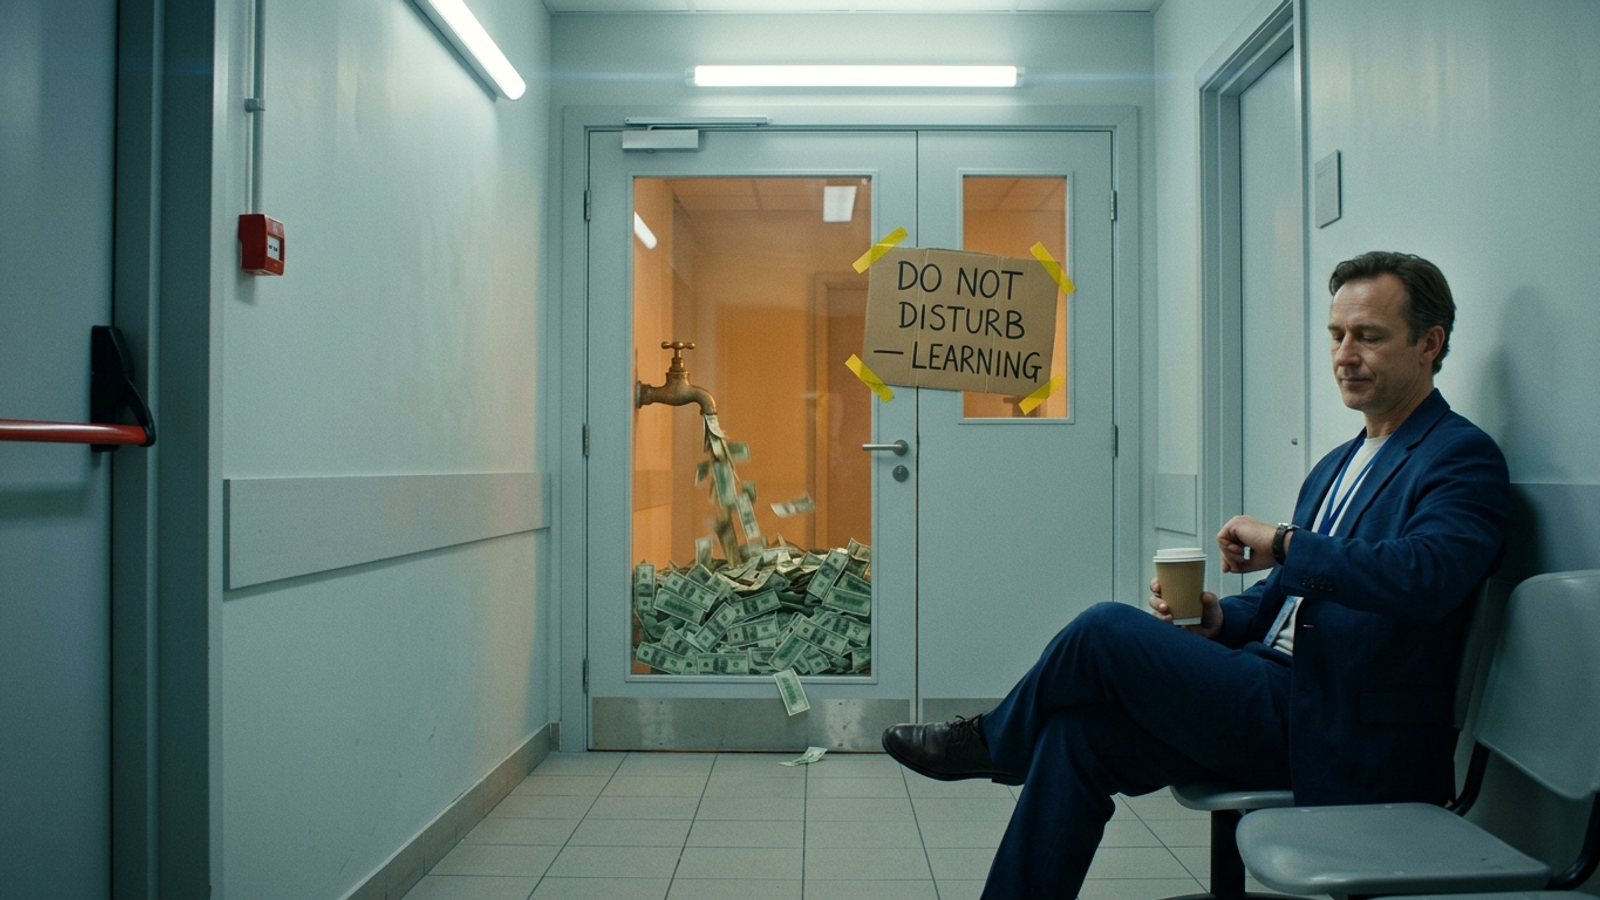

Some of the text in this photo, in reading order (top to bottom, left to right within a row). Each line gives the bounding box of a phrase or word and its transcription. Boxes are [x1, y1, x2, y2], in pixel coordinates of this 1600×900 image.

[897, 261, 1023, 300] DO NOT
[899, 301, 1025, 339] DISTURB
[912, 341, 1042, 383] LEARNING
